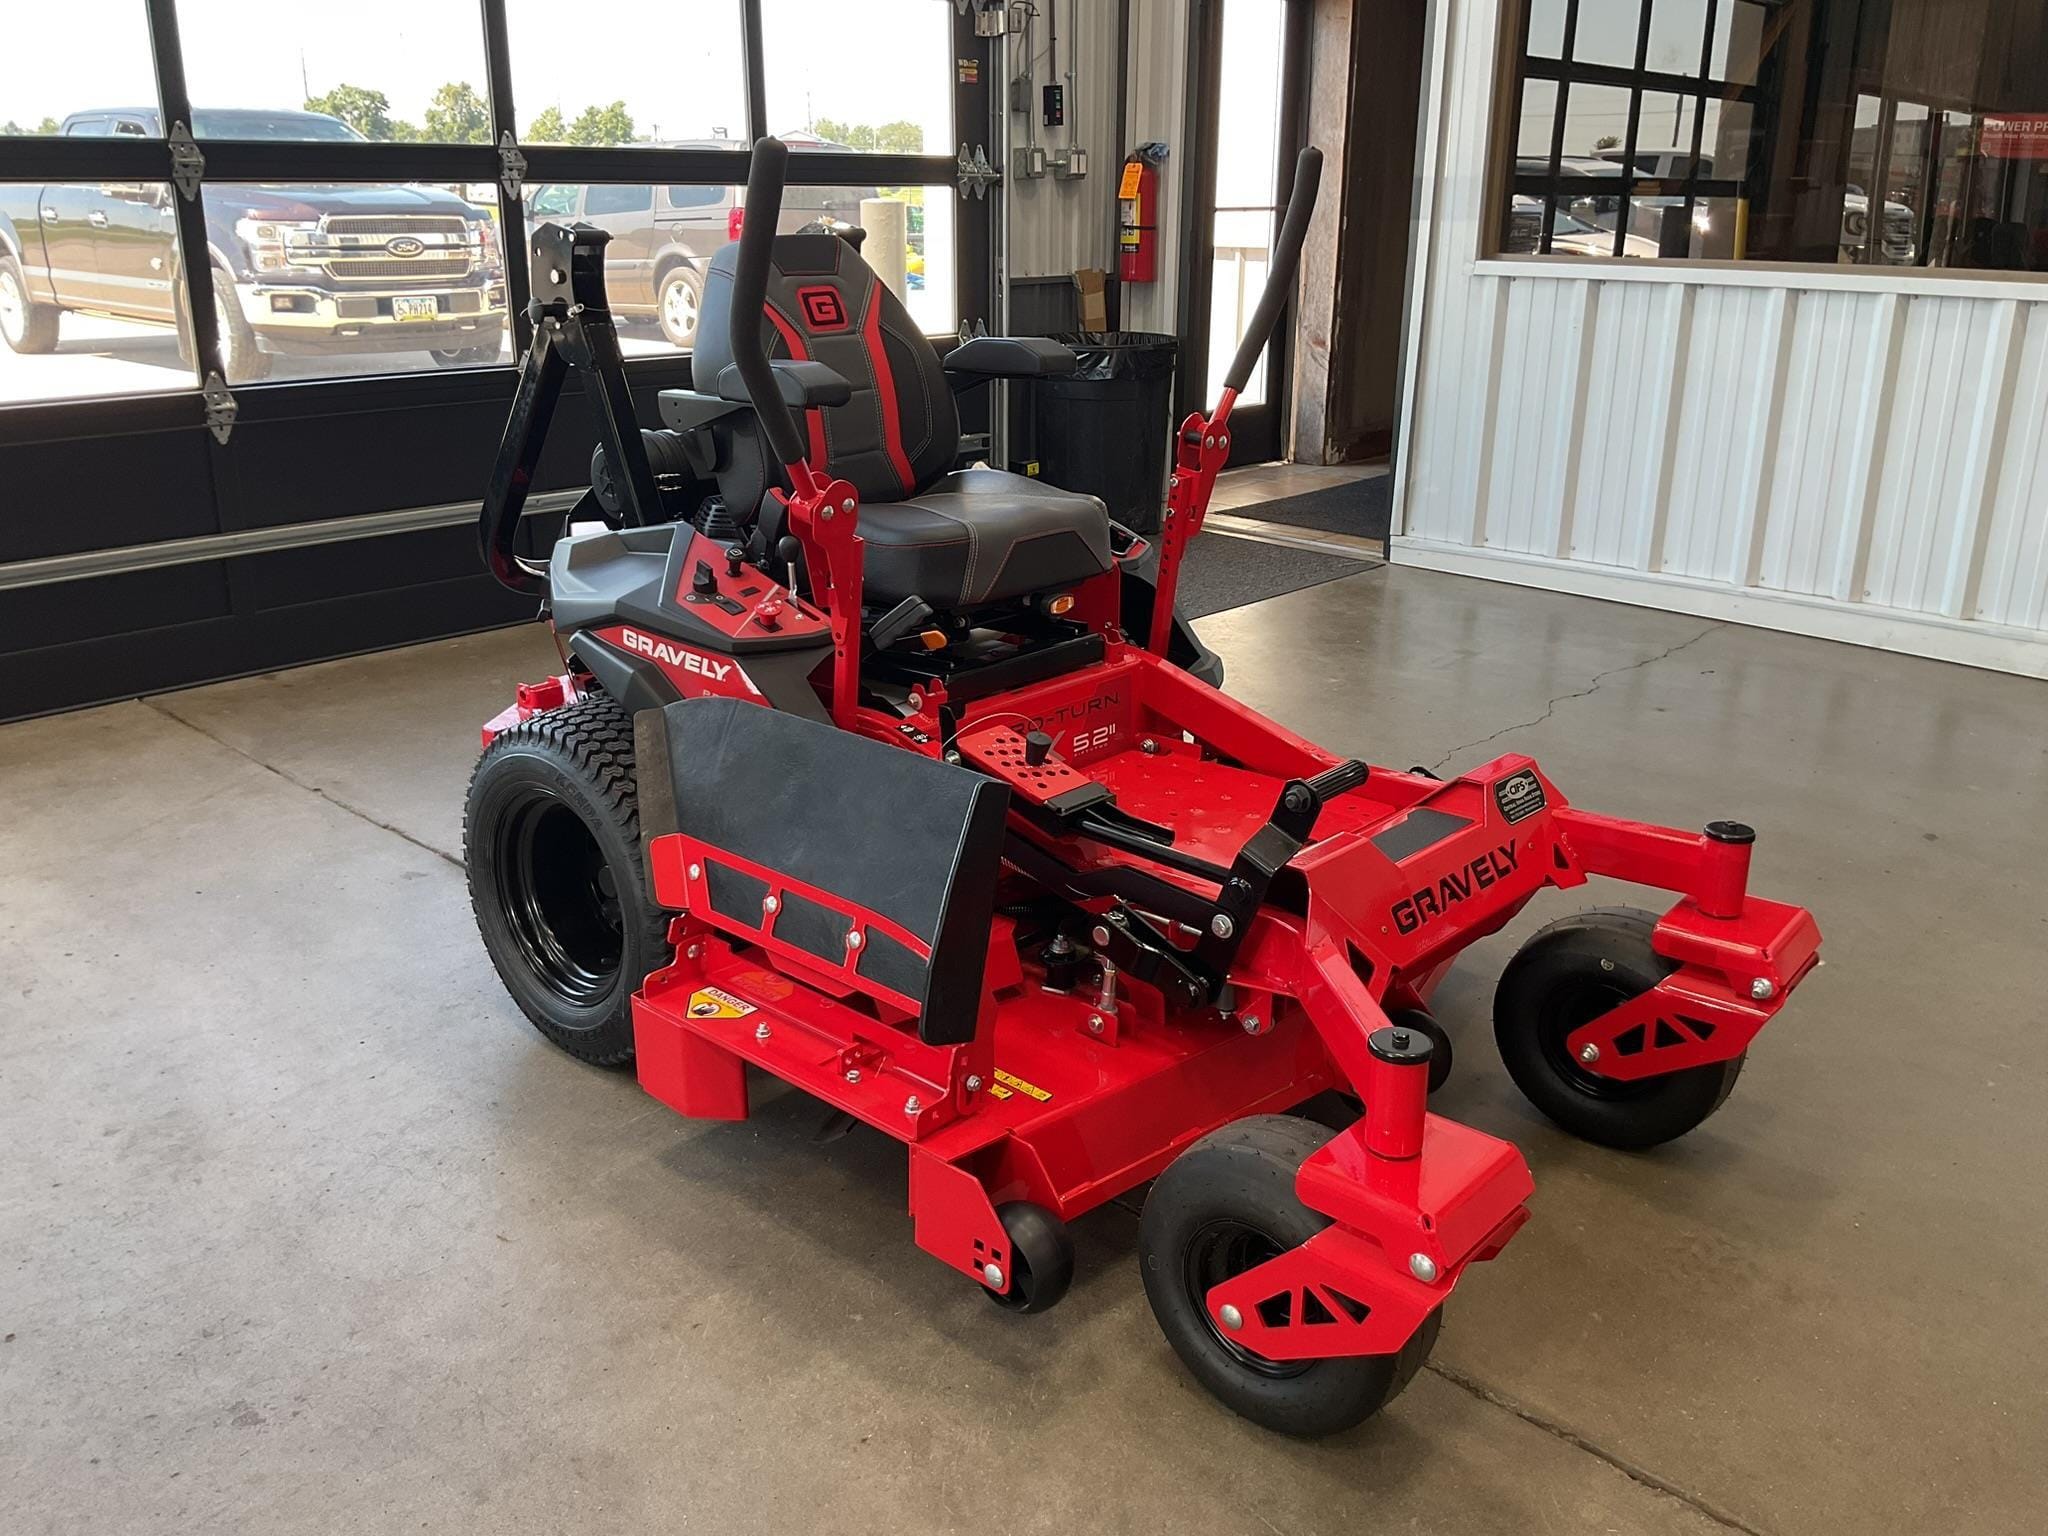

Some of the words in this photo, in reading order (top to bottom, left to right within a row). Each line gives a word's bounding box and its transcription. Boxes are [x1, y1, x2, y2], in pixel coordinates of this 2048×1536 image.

[622, 628, 732, 682] GRAVELY
[1391, 838, 1519, 936] GRAVELY
[708, 989, 750, 1011] DANGER
